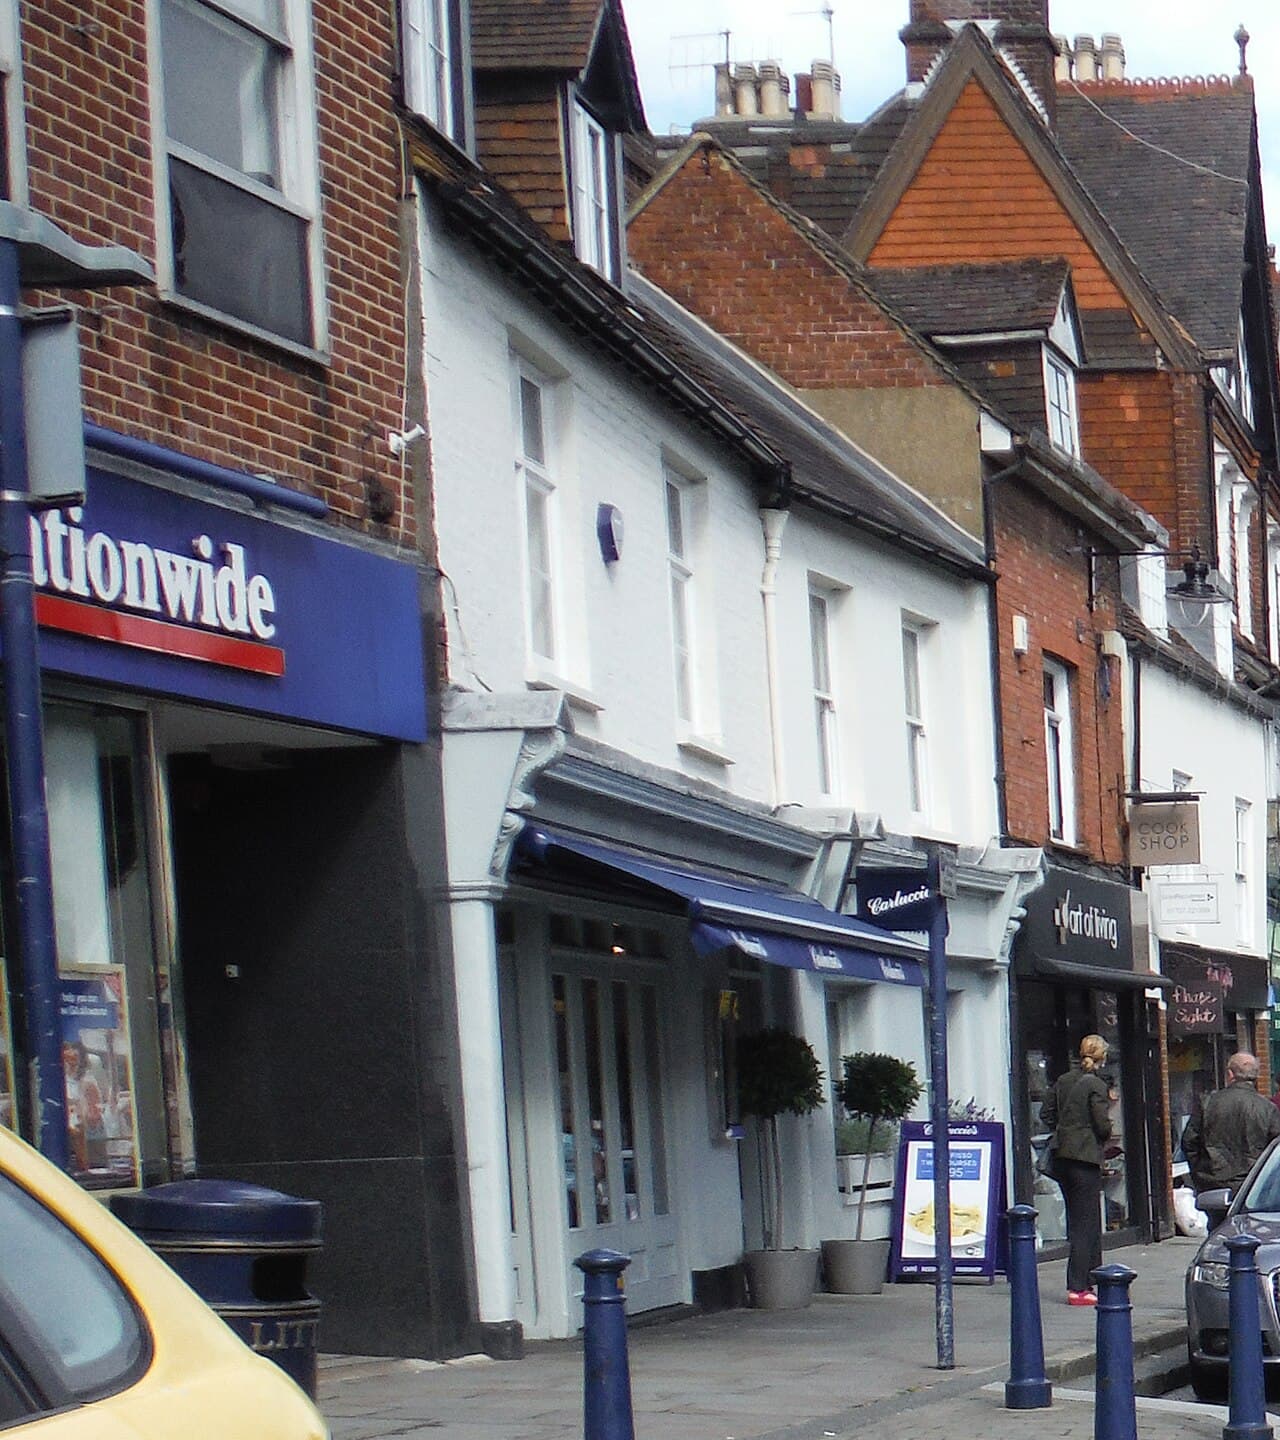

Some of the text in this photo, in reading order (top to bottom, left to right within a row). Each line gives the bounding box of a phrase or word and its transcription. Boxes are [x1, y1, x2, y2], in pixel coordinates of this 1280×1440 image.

[1137, 823, 1188, 835] COOK
[1140, 835, 1189, 850] SHOP
[1069, 903, 1083, 934] art
[1094, 907, 1118, 949] living
